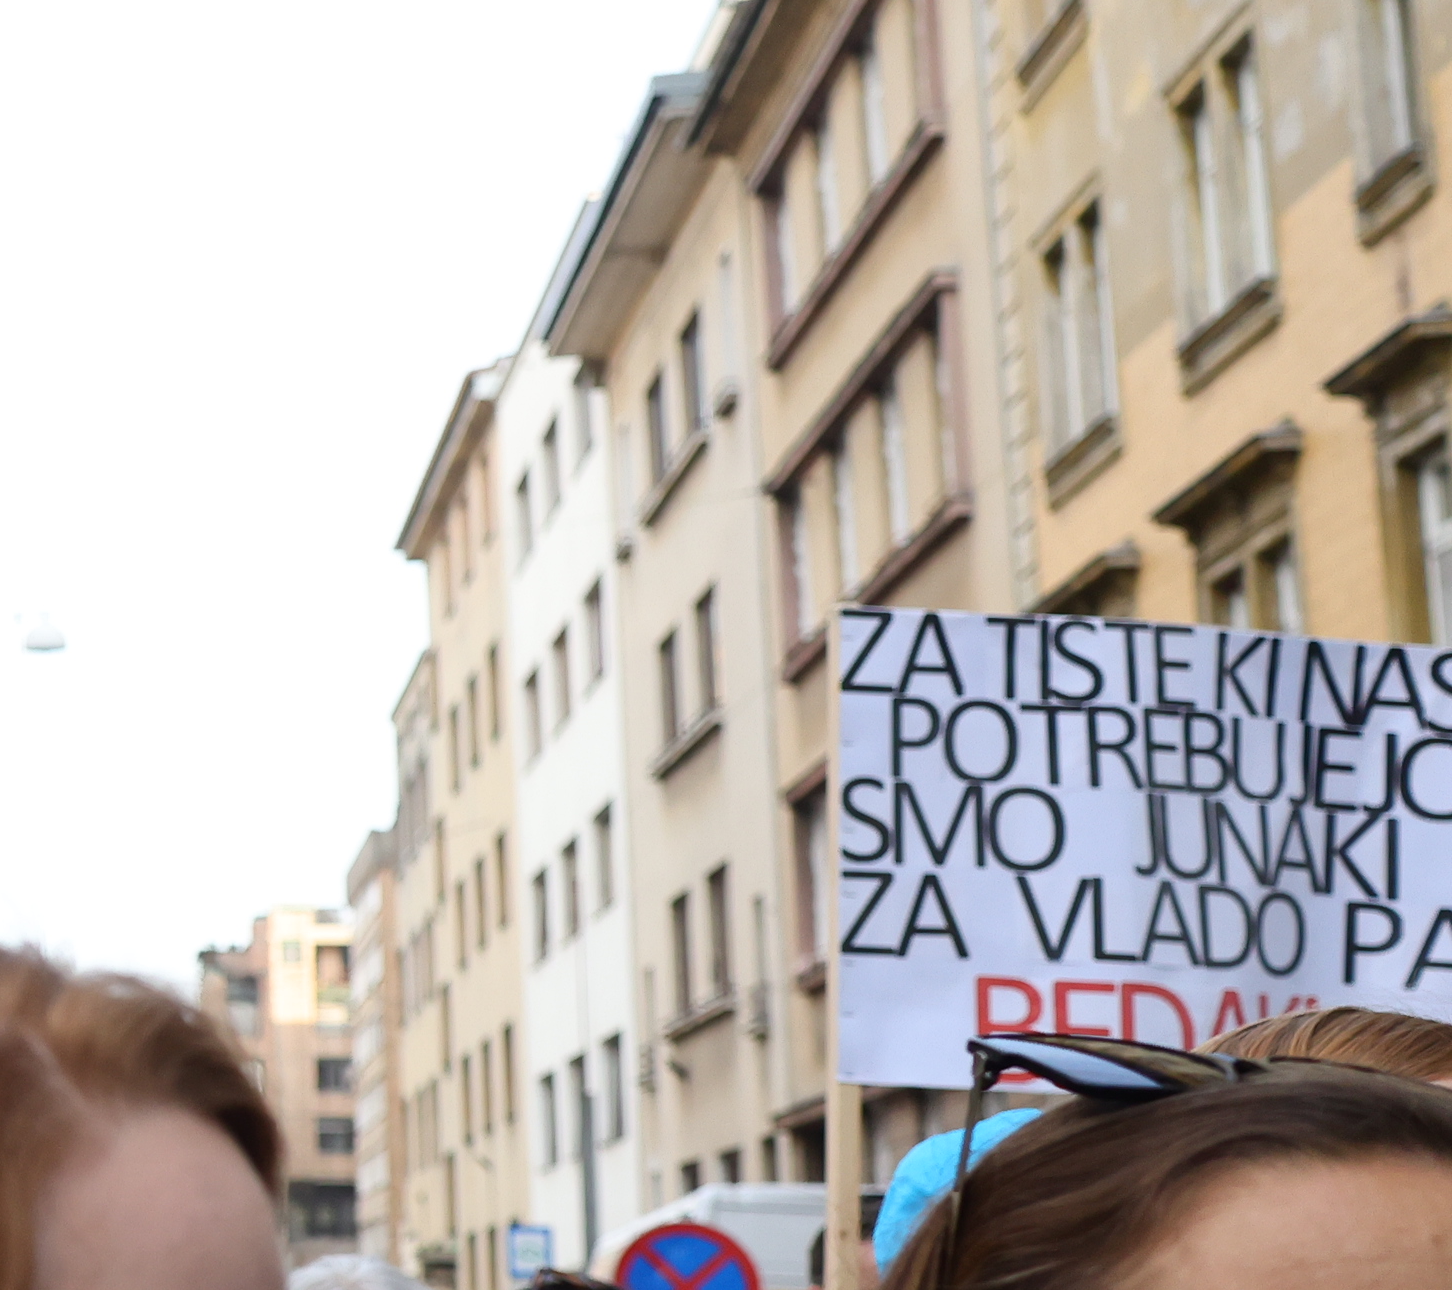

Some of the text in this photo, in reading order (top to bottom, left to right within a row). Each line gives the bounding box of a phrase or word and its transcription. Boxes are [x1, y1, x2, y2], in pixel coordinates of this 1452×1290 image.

[840, 610, 964, 696] ZA
[987, 616, 1196, 708] TISTE
[1218, 632, 1281, 718] KI
[891, 698, 1452, 822] POTREBUJEJO
[839, 778, 1400, 901] SMO JUNAKI
[840, 871, 970, 959] ZA
[1017, 874, 1308, 977] VLADO
